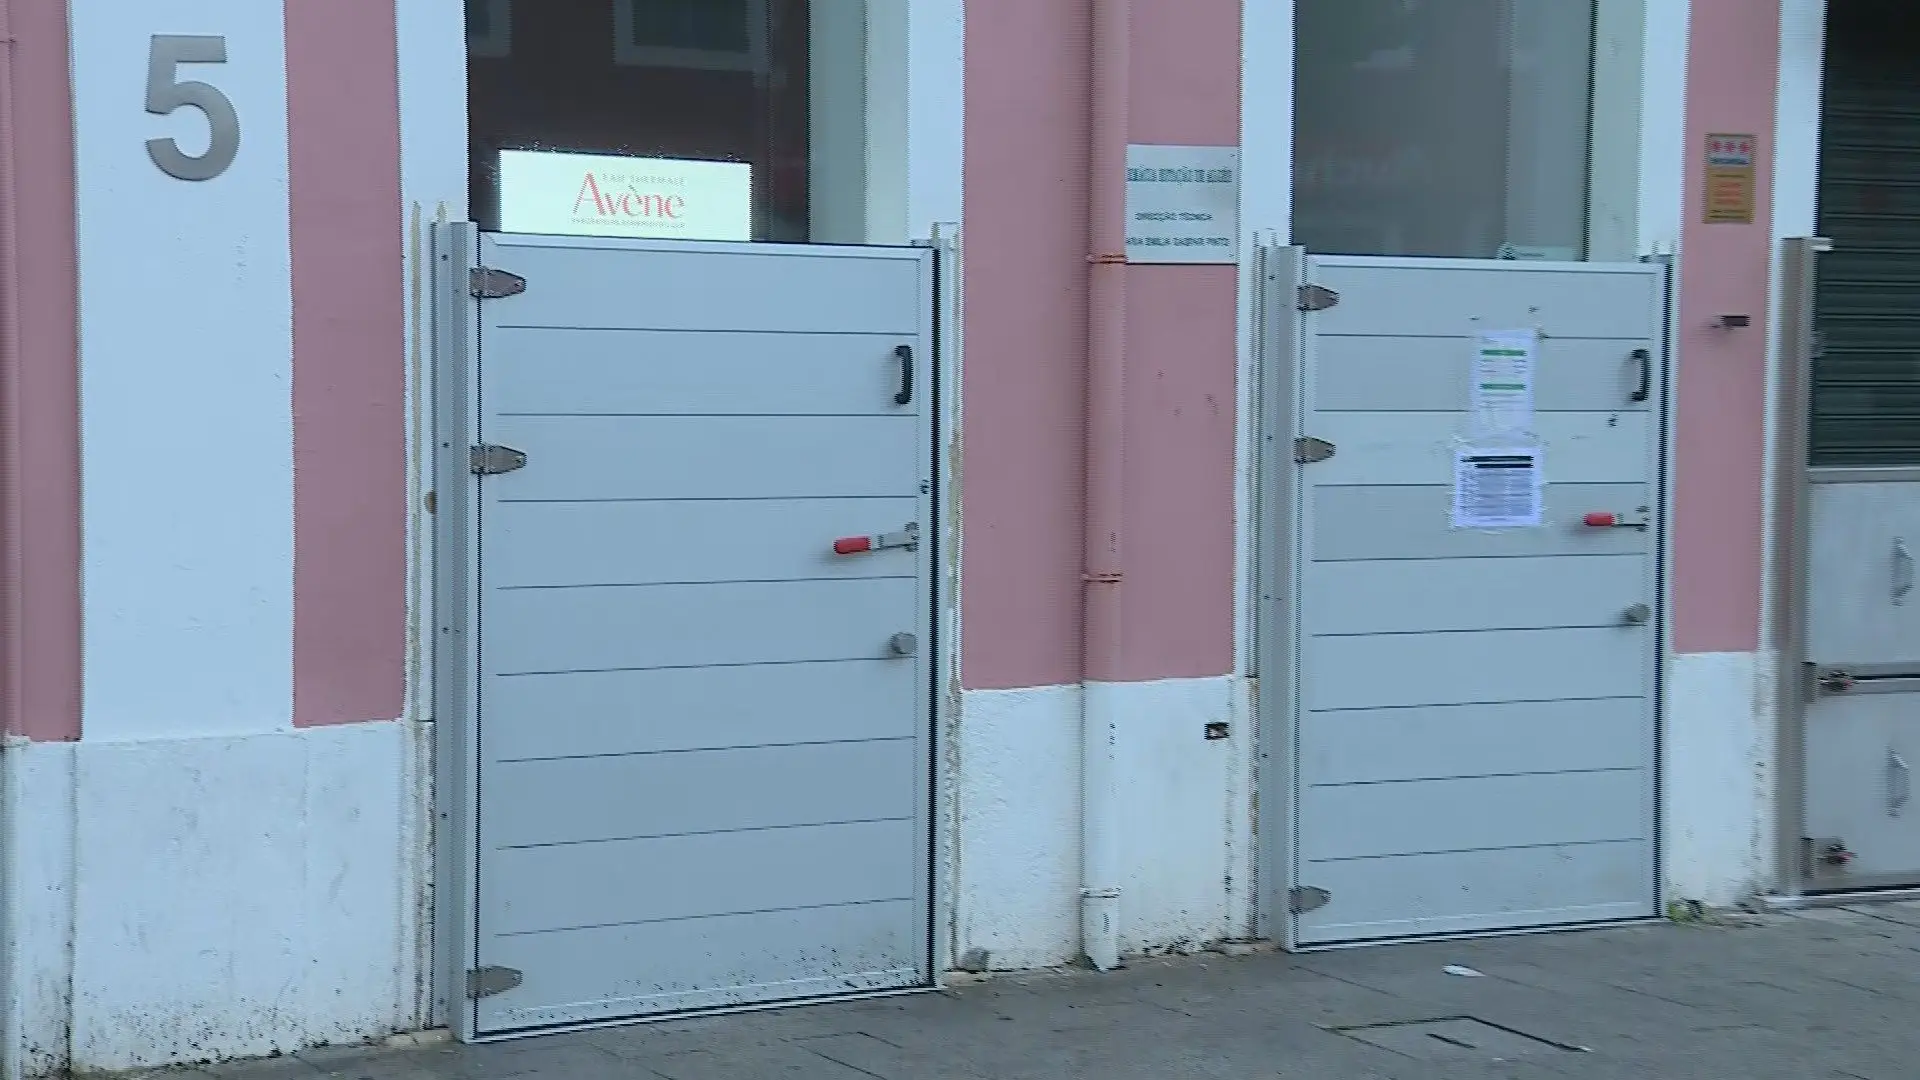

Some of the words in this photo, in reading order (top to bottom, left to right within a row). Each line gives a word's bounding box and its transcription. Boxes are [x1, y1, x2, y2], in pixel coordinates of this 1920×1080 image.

[145, 34, 240, 181] 5
[572, 171, 685, 219] Avène
[1206, 237, 1231, 248] PINTO
